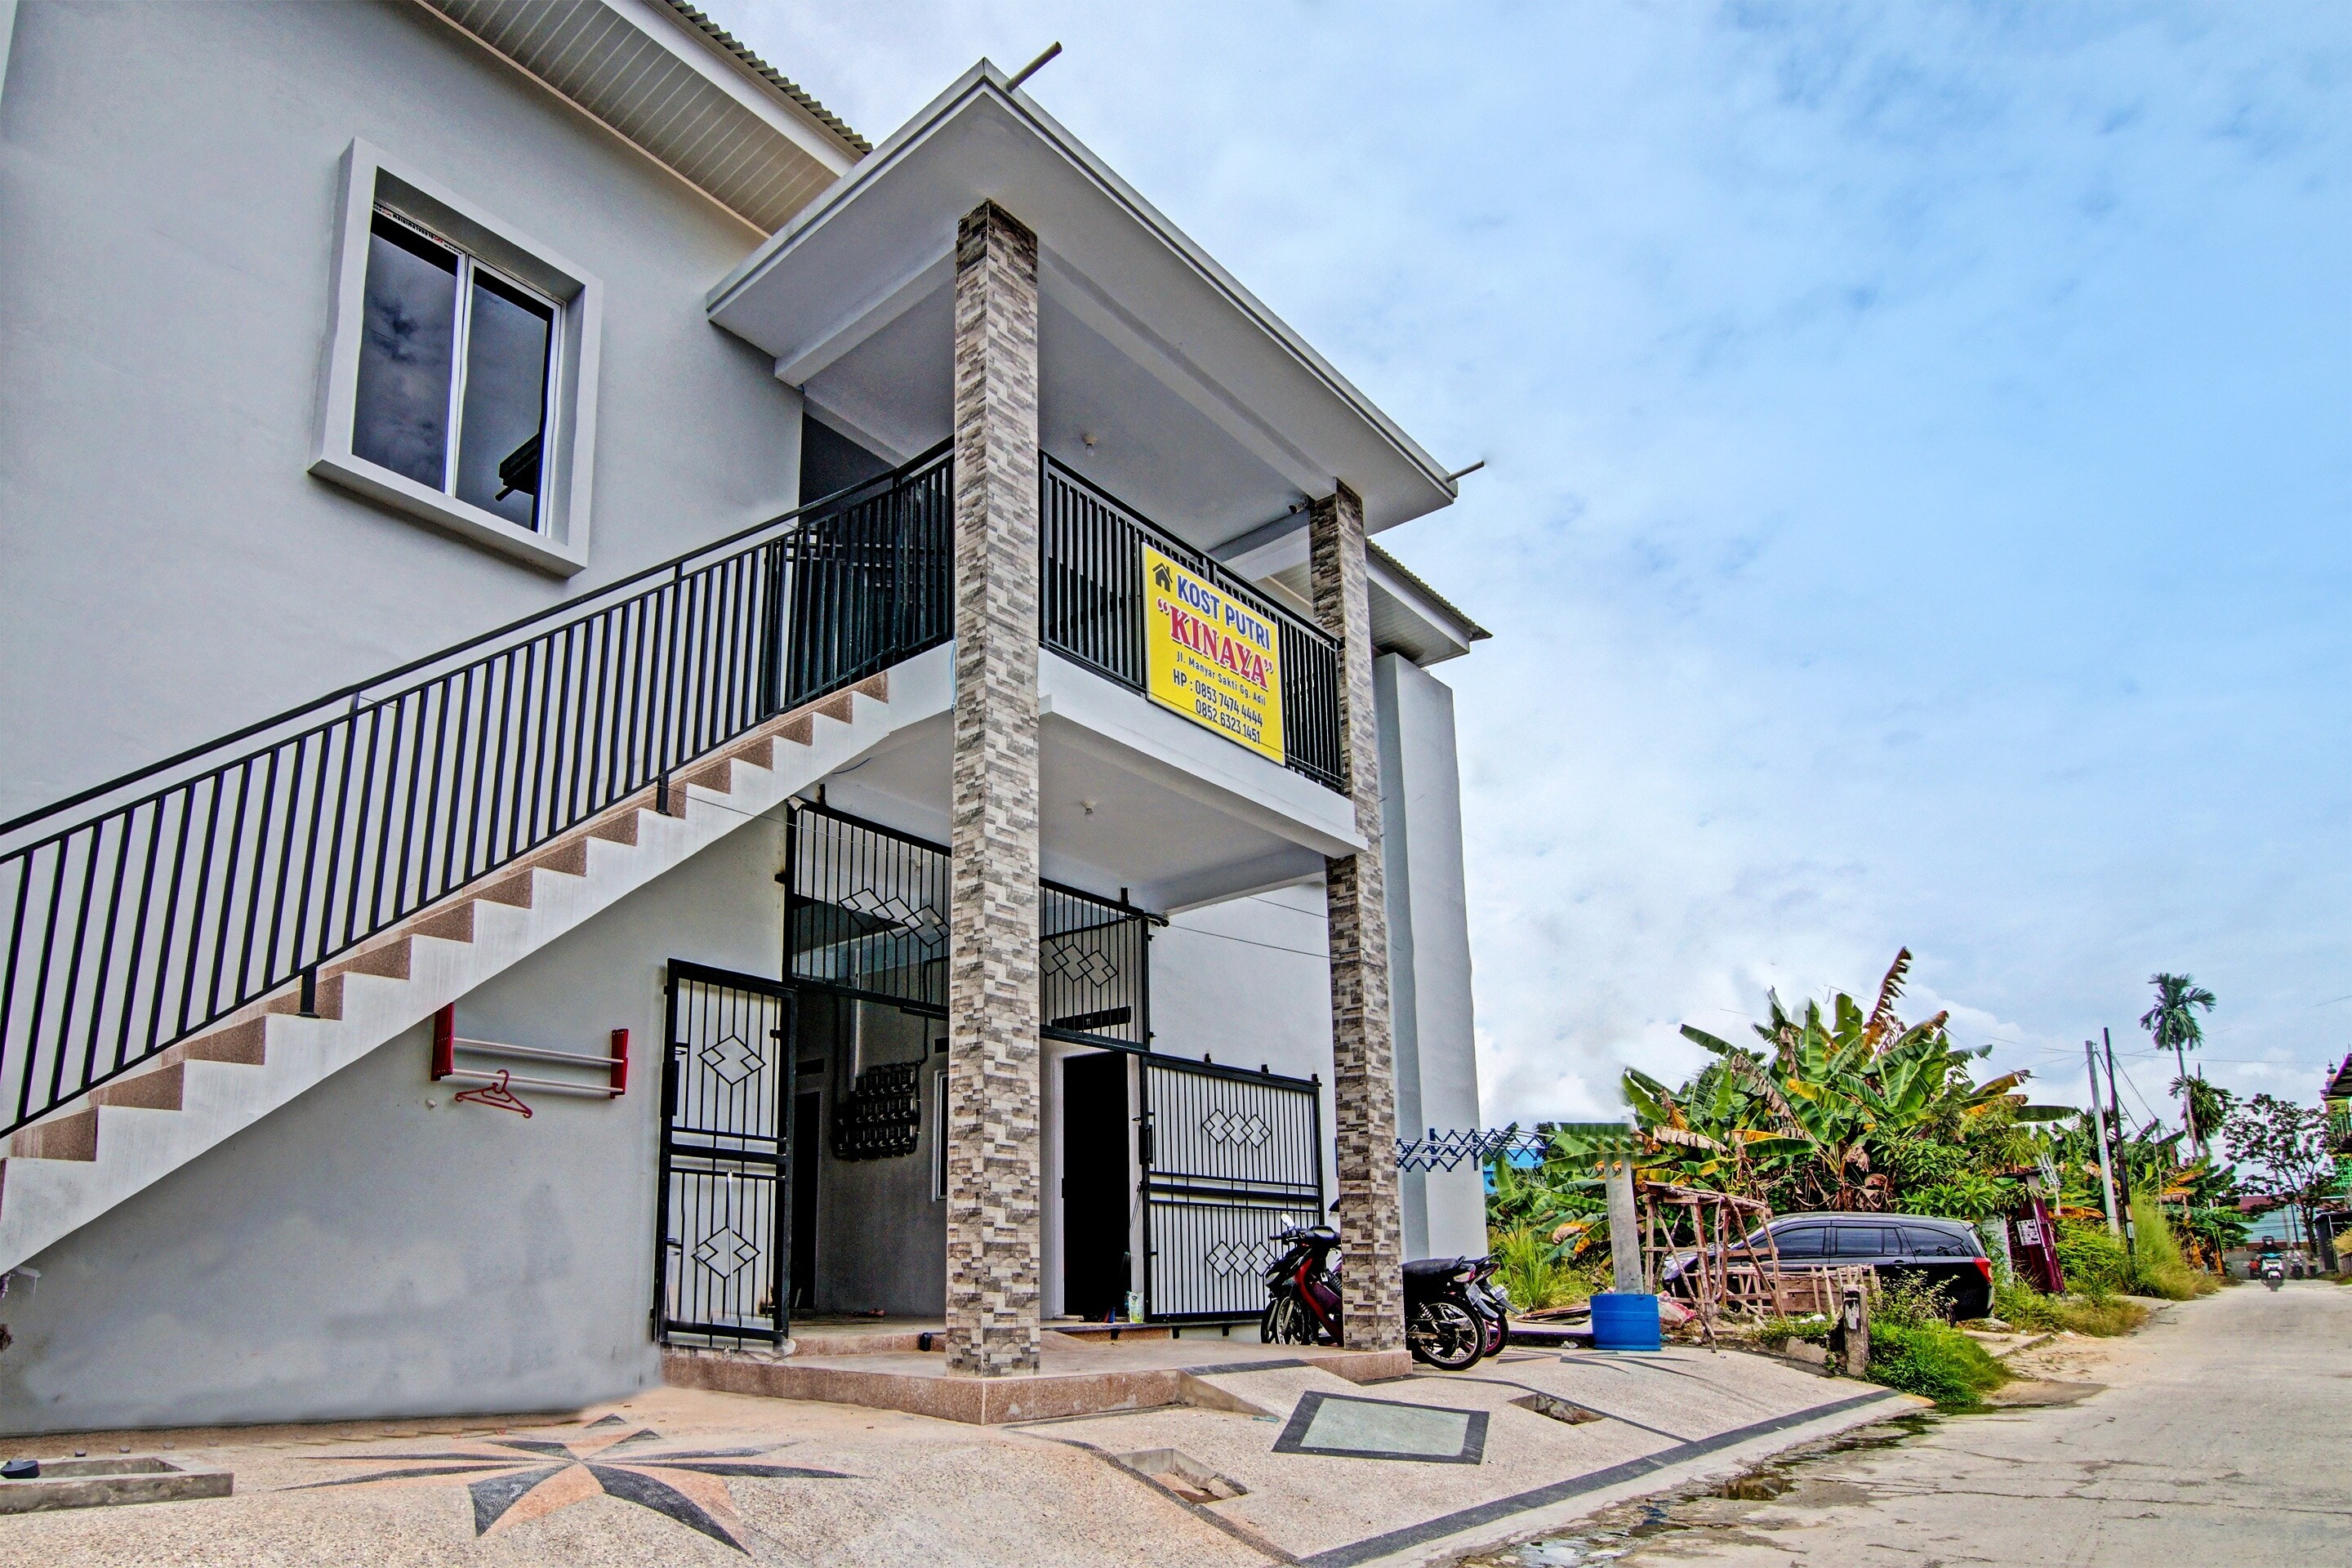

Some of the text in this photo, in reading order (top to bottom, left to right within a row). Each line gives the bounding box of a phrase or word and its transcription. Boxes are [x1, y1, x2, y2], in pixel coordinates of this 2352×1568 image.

[1178, 574, 1270, 651] KOST PUTRI
[1173, 668, 1187, 687] HP
[1195, 679, 1217, 704] 0853
[1219, 692, 1240, 715] 7474
[1241, 704, 1263, 728] 4444
[1188, 656, 1216, 679] Manyar
[1218, 673, 1237, 691] Sakti
[1240, 684, 1251, 699] Gg.
[1253, 692, 1266, 706] Adil
[1196, 698, 1261, 745] 0852 6323 1451
